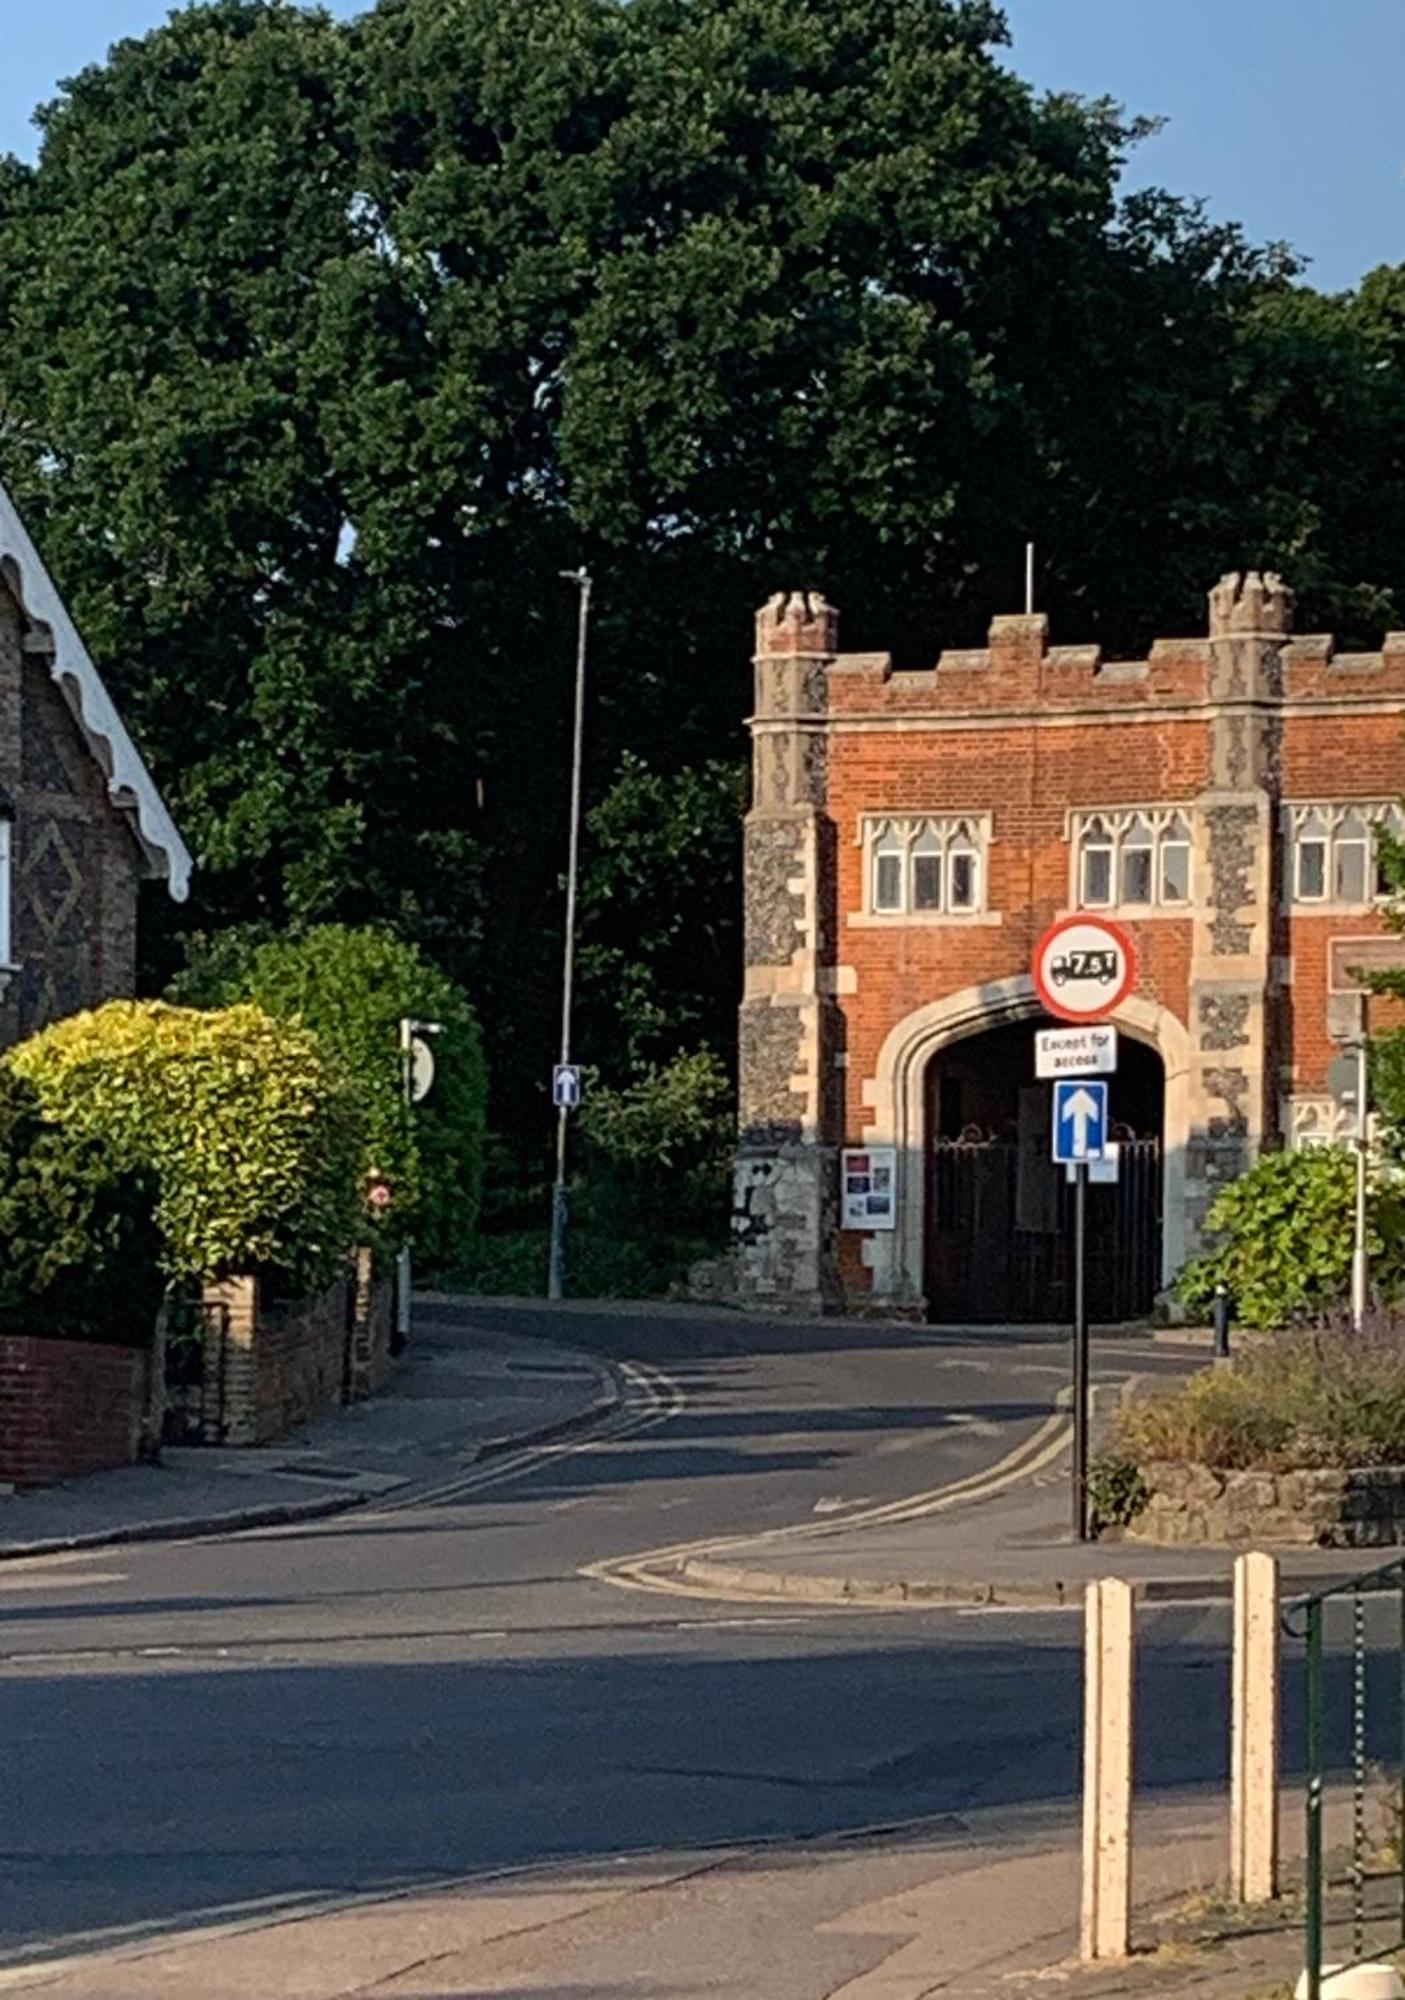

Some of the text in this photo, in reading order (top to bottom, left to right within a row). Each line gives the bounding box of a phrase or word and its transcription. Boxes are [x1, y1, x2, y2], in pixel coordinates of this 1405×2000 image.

[1041, 1033, 1110, 1053] Except for
[1053, 1055, 1098, 1068] access
